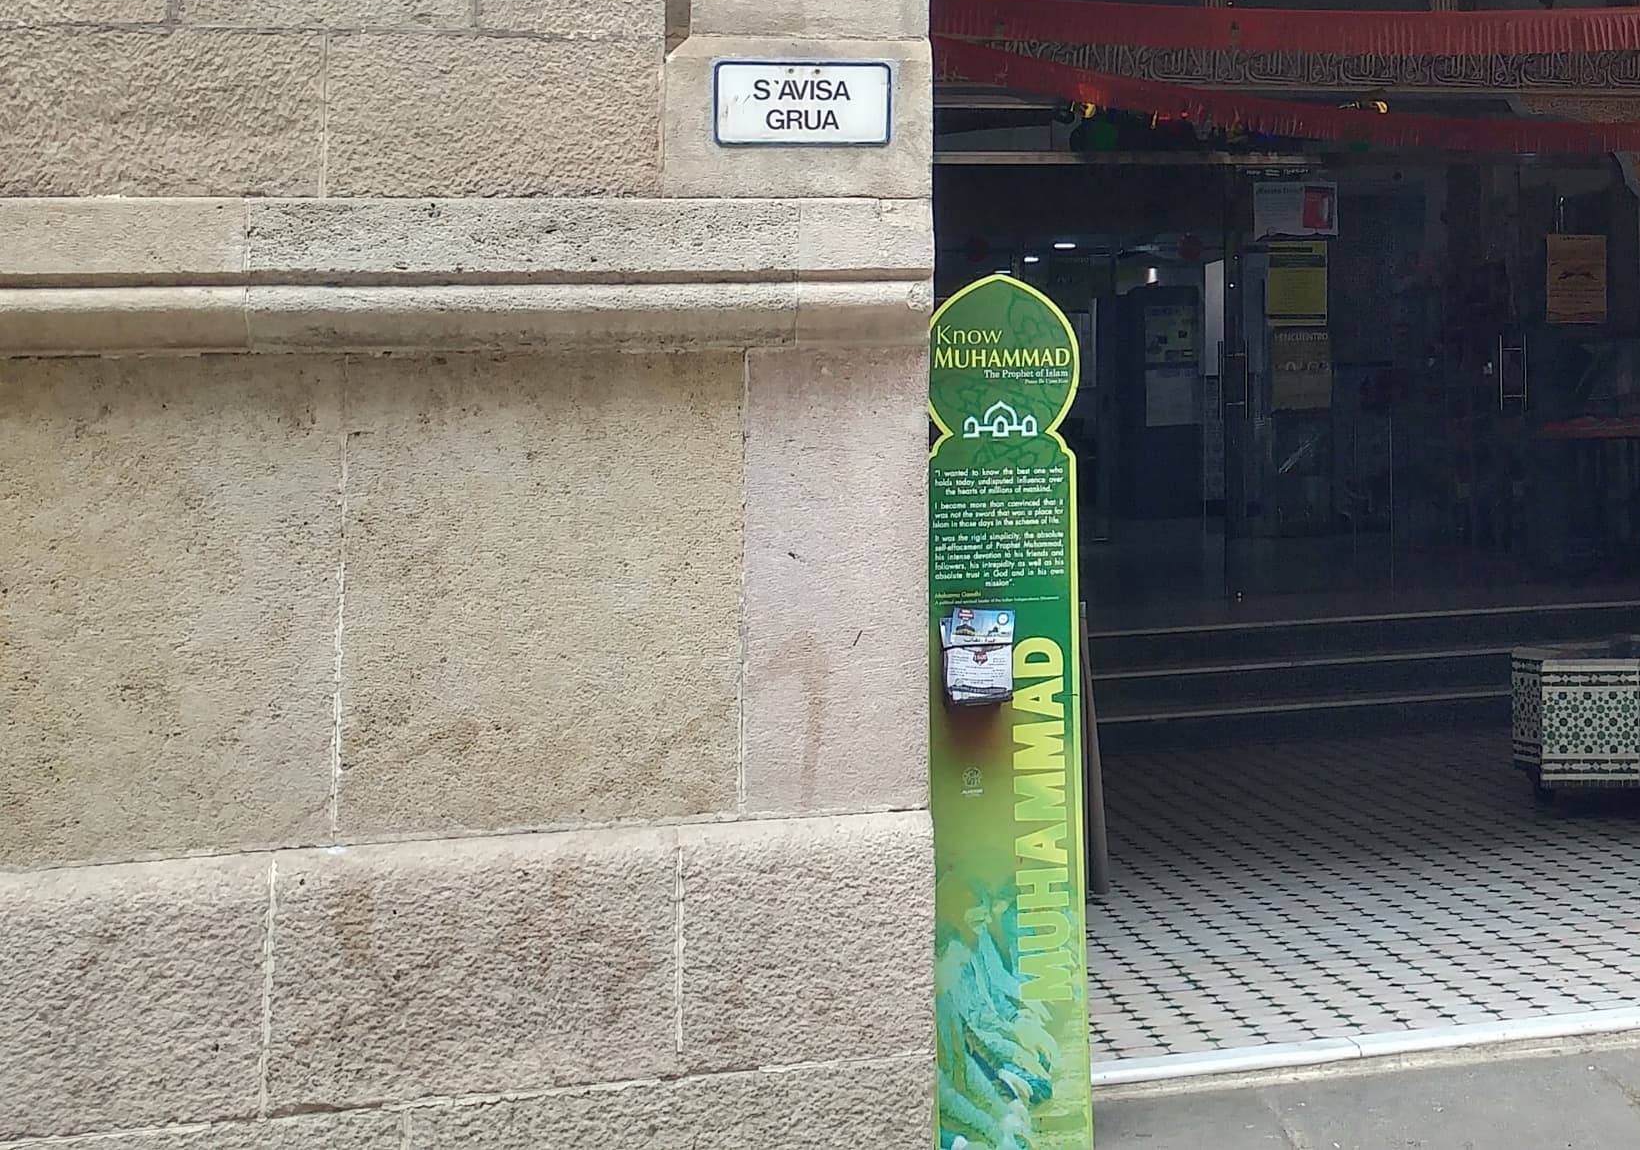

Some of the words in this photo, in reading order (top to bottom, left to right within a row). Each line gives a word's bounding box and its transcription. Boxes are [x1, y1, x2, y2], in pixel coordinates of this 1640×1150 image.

[766, 110, 839, 130] GRUA
[936, 325, 1002, 345] Know
[934, 348, 1071, 369] MUHAMMAD
[984, 370, 1000, 378] The
[1002, 370, 1034, 379] Prophet
[1035, 370, 1044, 378] of
[1045, 369, 1068, 378] Islam
[1012, 637, 1072, 1003] MUHAMMAD
